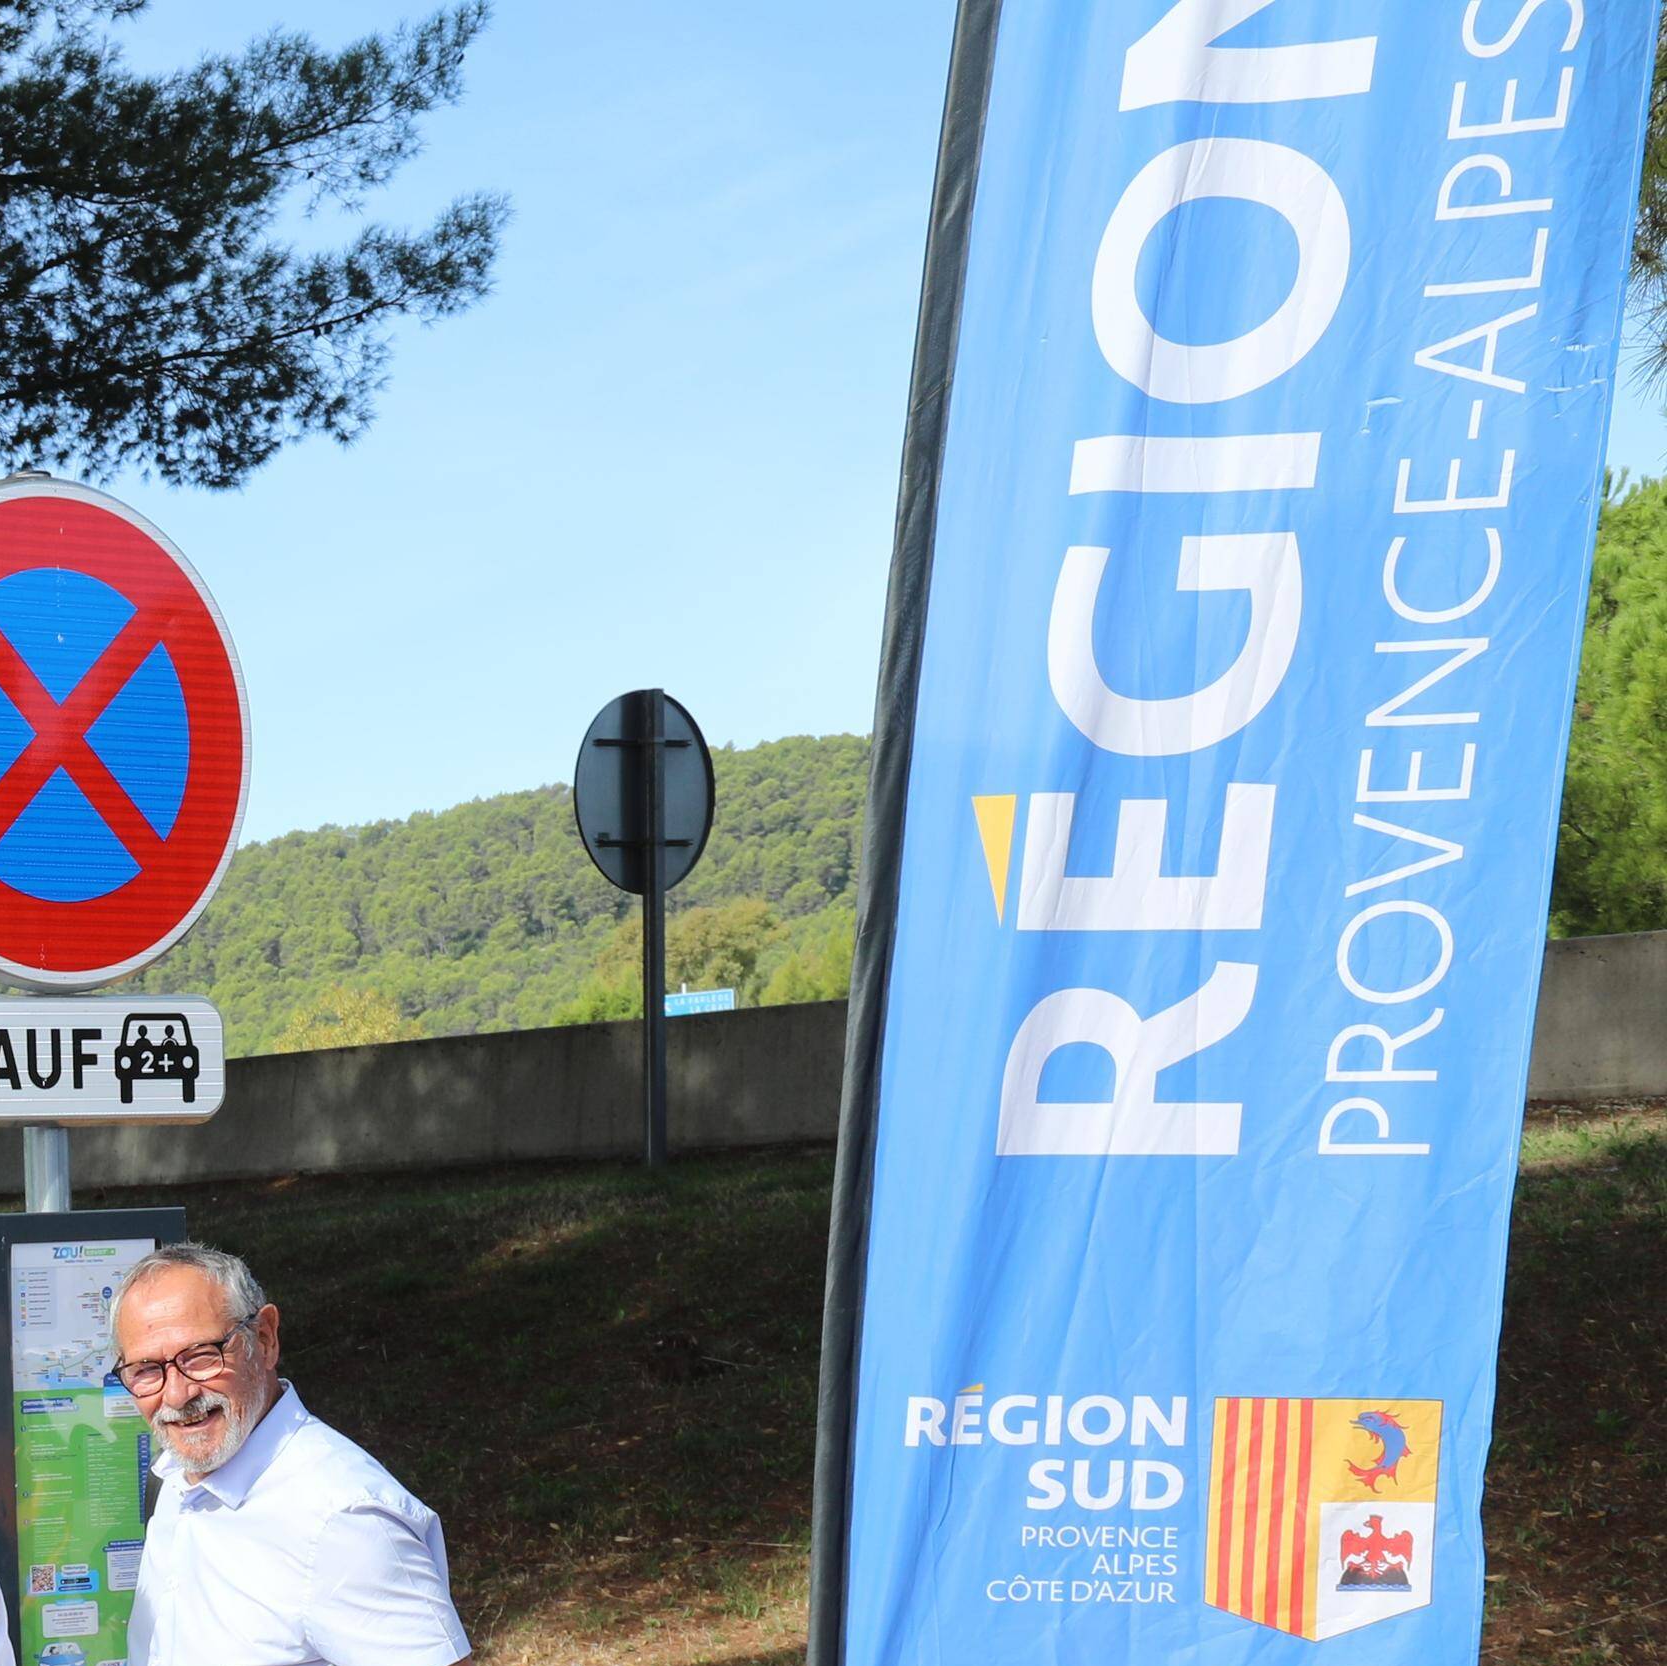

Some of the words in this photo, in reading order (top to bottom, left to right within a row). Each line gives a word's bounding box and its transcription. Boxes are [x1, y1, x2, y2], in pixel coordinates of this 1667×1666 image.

[904, 1383, 1188, 1447] RÉGION
[1026, 1458, 1185, 1511] SUD
[1021, 1525, 1178, 1549] PROVENCE
[1091, 1553, 1178, 1576] ALPES
[986, 1574, 1064, 1603] CÔTE
[1071, 1579, 1177, 1604] D'AZUR
